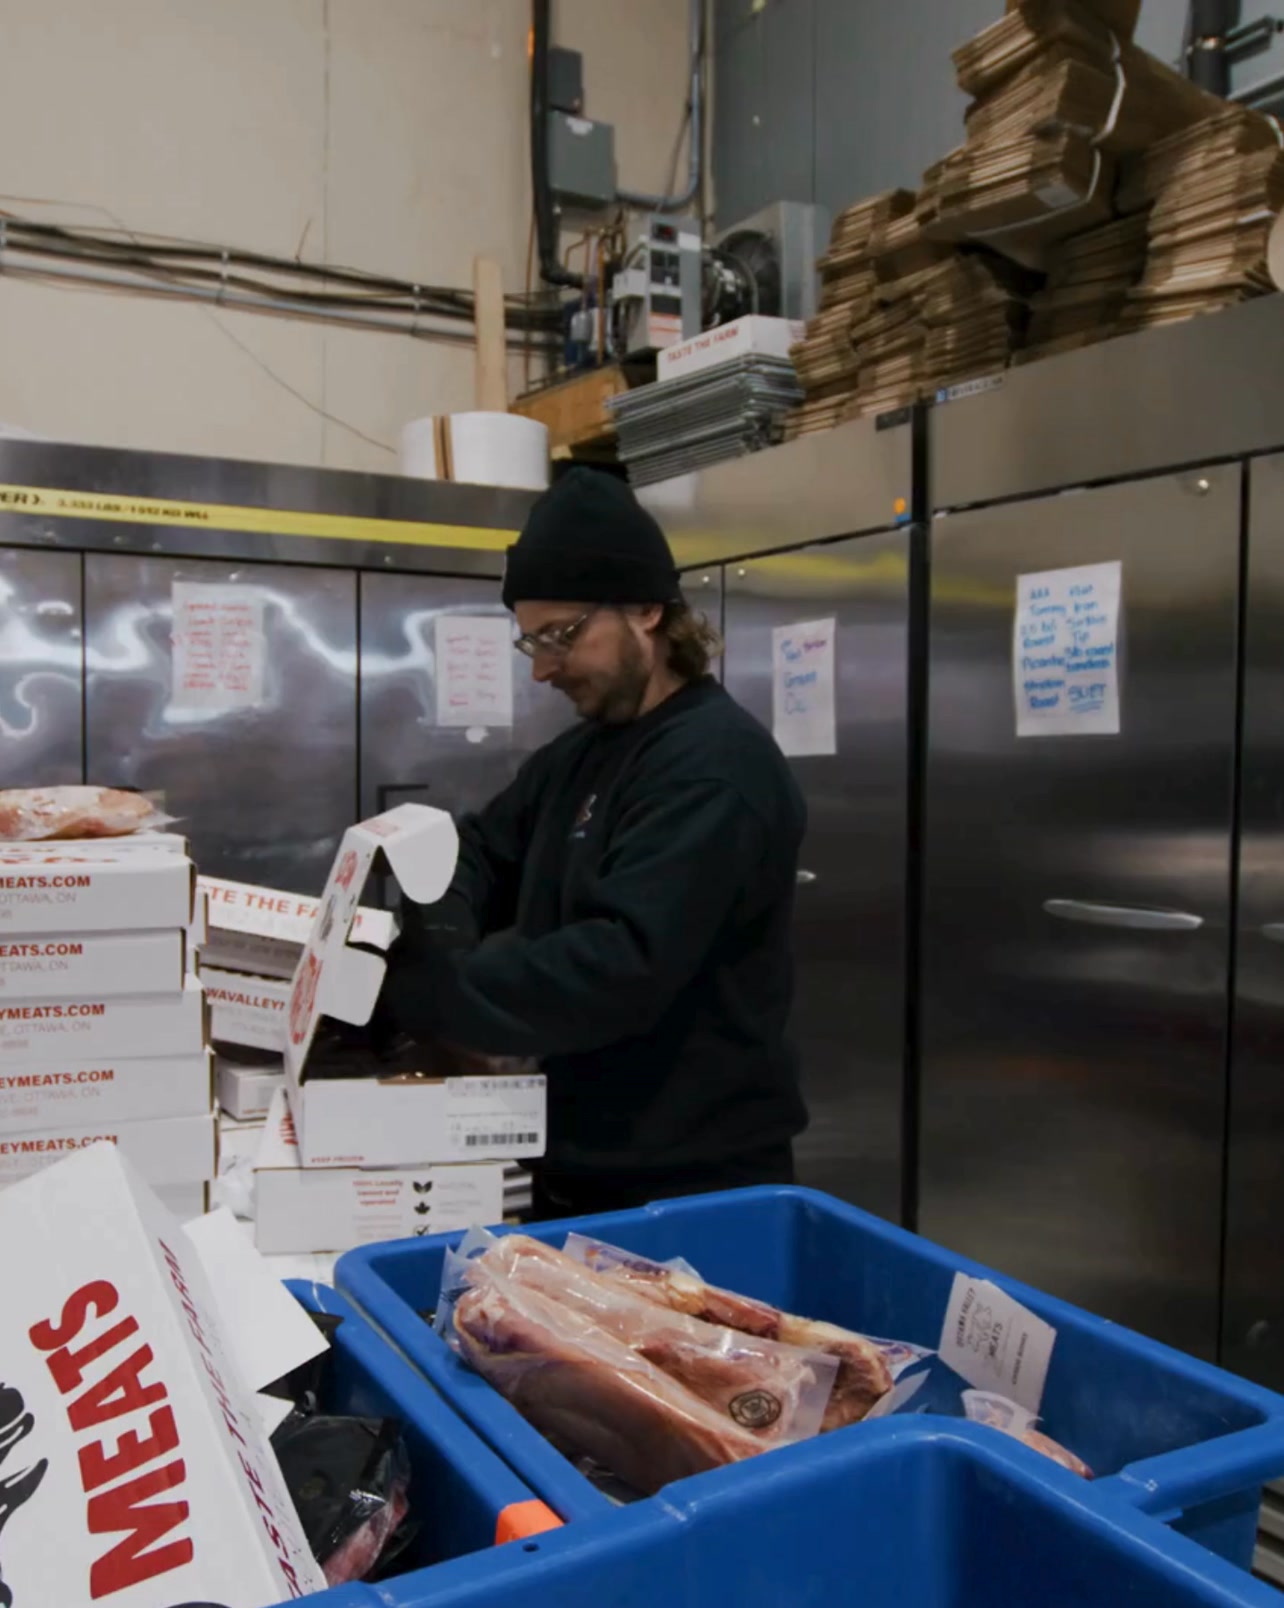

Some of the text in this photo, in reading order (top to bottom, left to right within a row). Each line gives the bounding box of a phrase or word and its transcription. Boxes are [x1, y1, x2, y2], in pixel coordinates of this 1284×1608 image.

[695, 338, 711, 352] THE
[240, 892, 292, 915] THE
[159, 1239, 213, 1356] FARM
[28, 1279, 194, 1600] MEATS
[201, 1352, 245, 1443] THE
